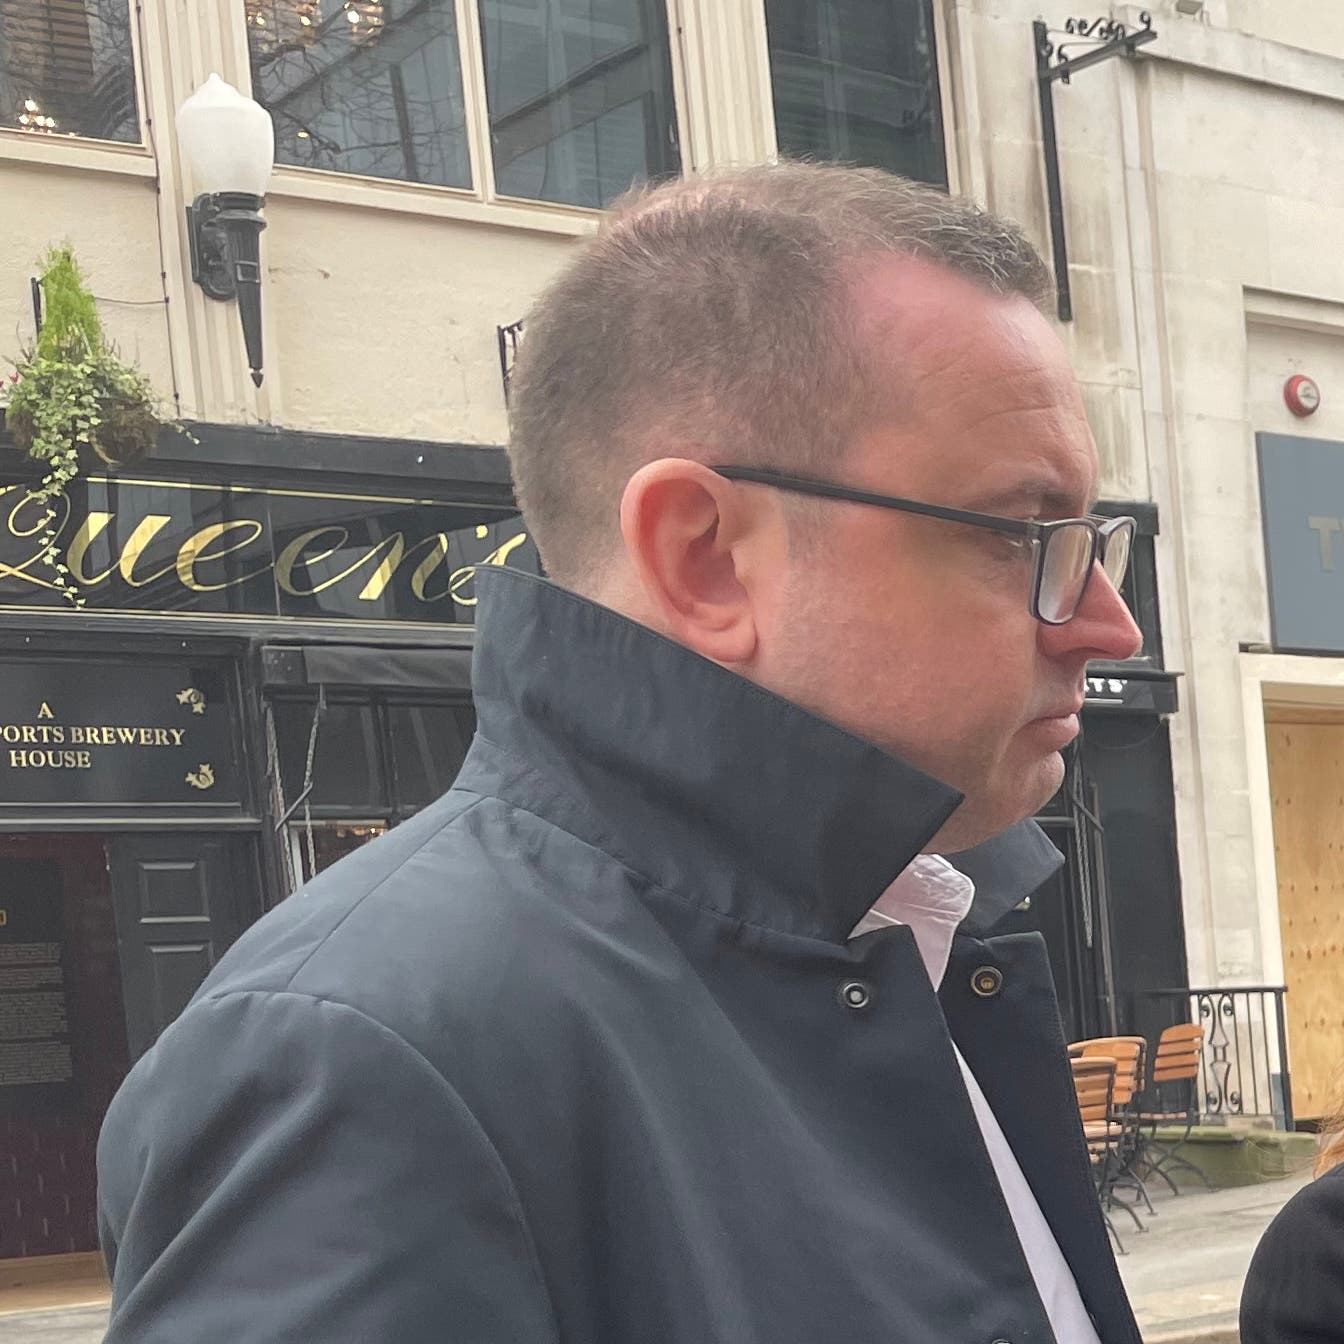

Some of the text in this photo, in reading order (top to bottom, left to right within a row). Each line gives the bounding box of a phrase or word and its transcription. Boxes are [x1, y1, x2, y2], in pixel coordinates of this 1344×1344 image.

[37, 702, 55, 719] A
[0, 725, 186, 746] ORTS BREWERY
[9, 750, 91, 768] HOUSE
